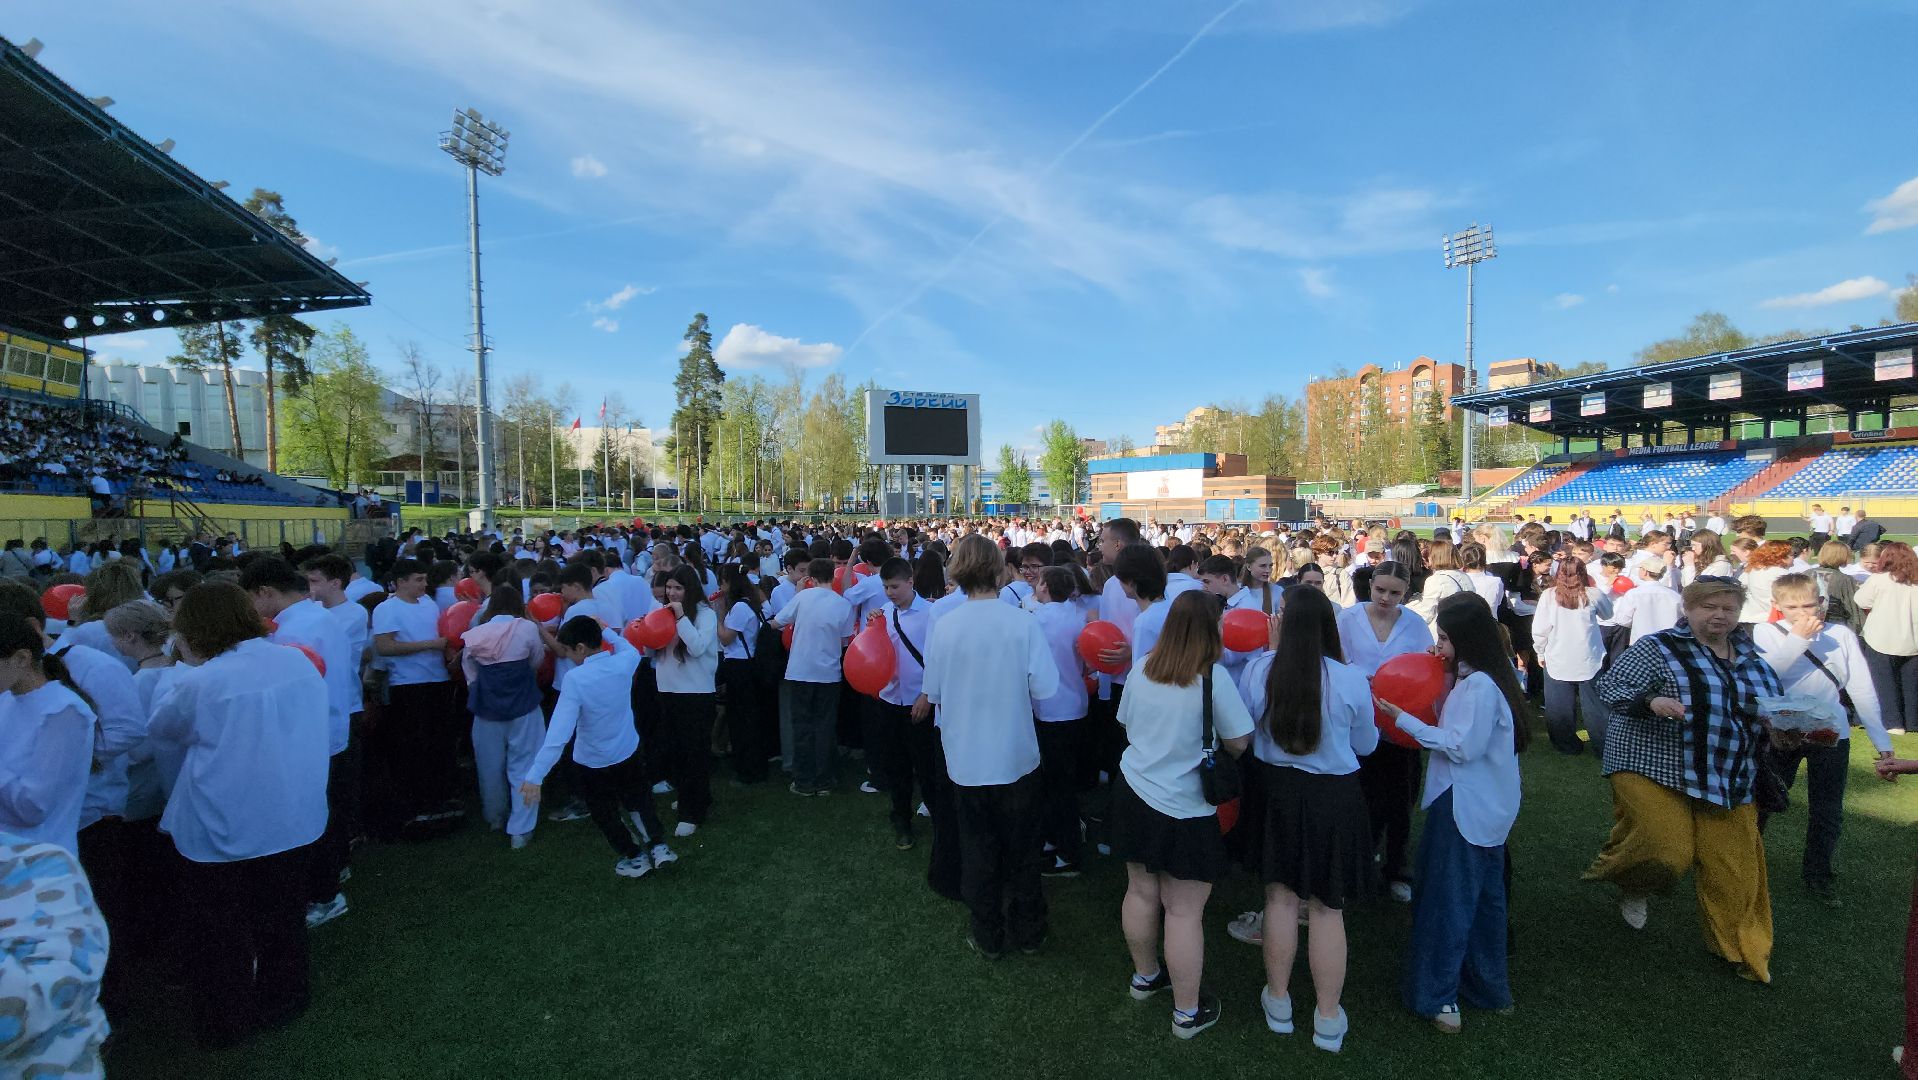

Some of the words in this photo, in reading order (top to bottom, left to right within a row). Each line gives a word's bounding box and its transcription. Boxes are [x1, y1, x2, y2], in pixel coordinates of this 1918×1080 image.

[884, 391, 967, 409] Зоркий
[1629, 446, 1651, 456] MEDIA
[1652, 443, 1688, 453] FOOTBALL
[1689, 441, 1720, 451] LEAGUE
